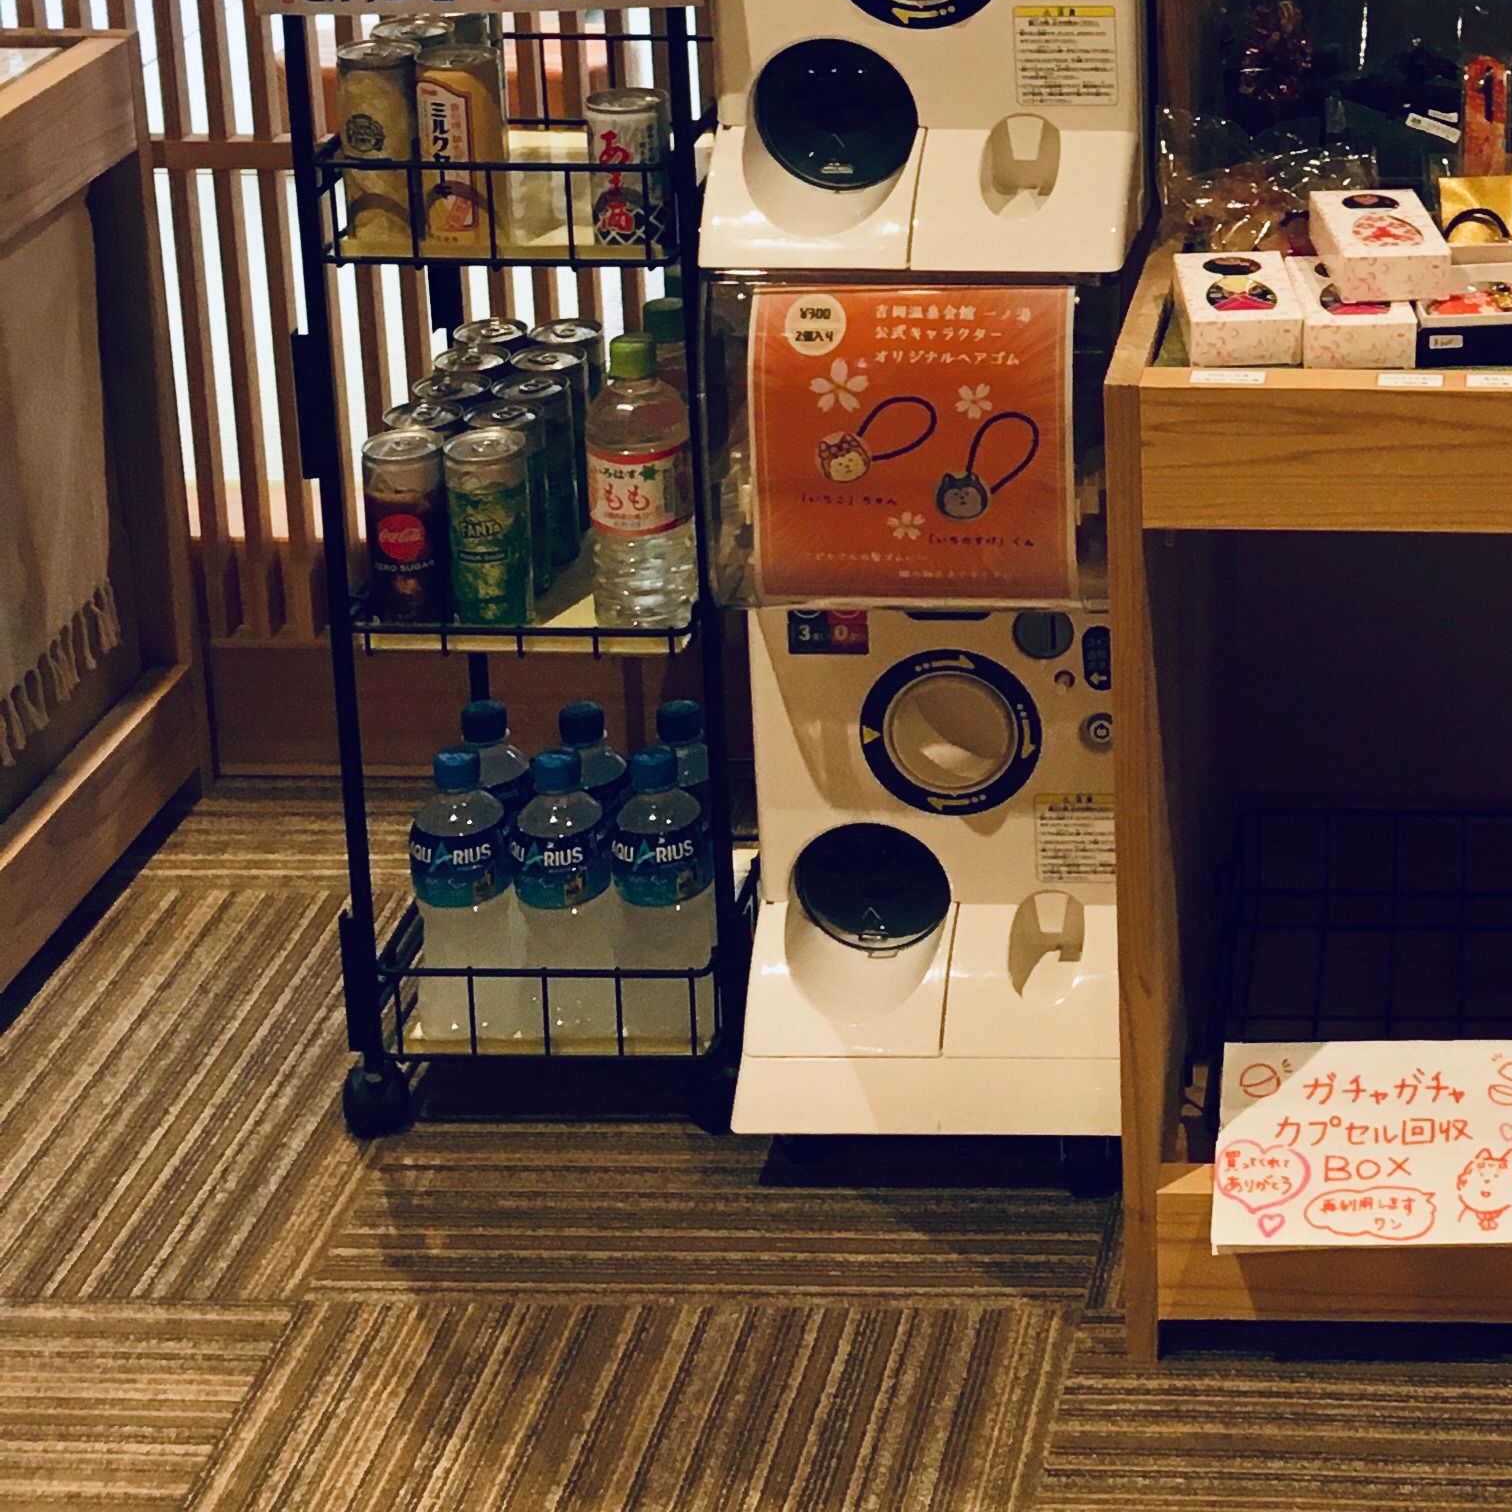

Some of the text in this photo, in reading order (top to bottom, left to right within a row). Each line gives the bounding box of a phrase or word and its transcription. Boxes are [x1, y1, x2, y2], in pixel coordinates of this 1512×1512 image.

[875, 325, 1002, 341] 公式キャラクター
[875, 350, 1020, 366] オリジナルヘアゴム
[603, 483, 651, 511] もも
[1303, 1067, 1465, 1106] ガチャガチャ
[1275, 1115, 1473, 1147] カプセル回収
[1224, 1151, 1290, 1173] 買ってくれて
[1324, 1155, 1412, 1182] BOX
[1224, 1175, 1294, 1194] ありがとう
[1373, 1217, 1403, 1230] ワン
